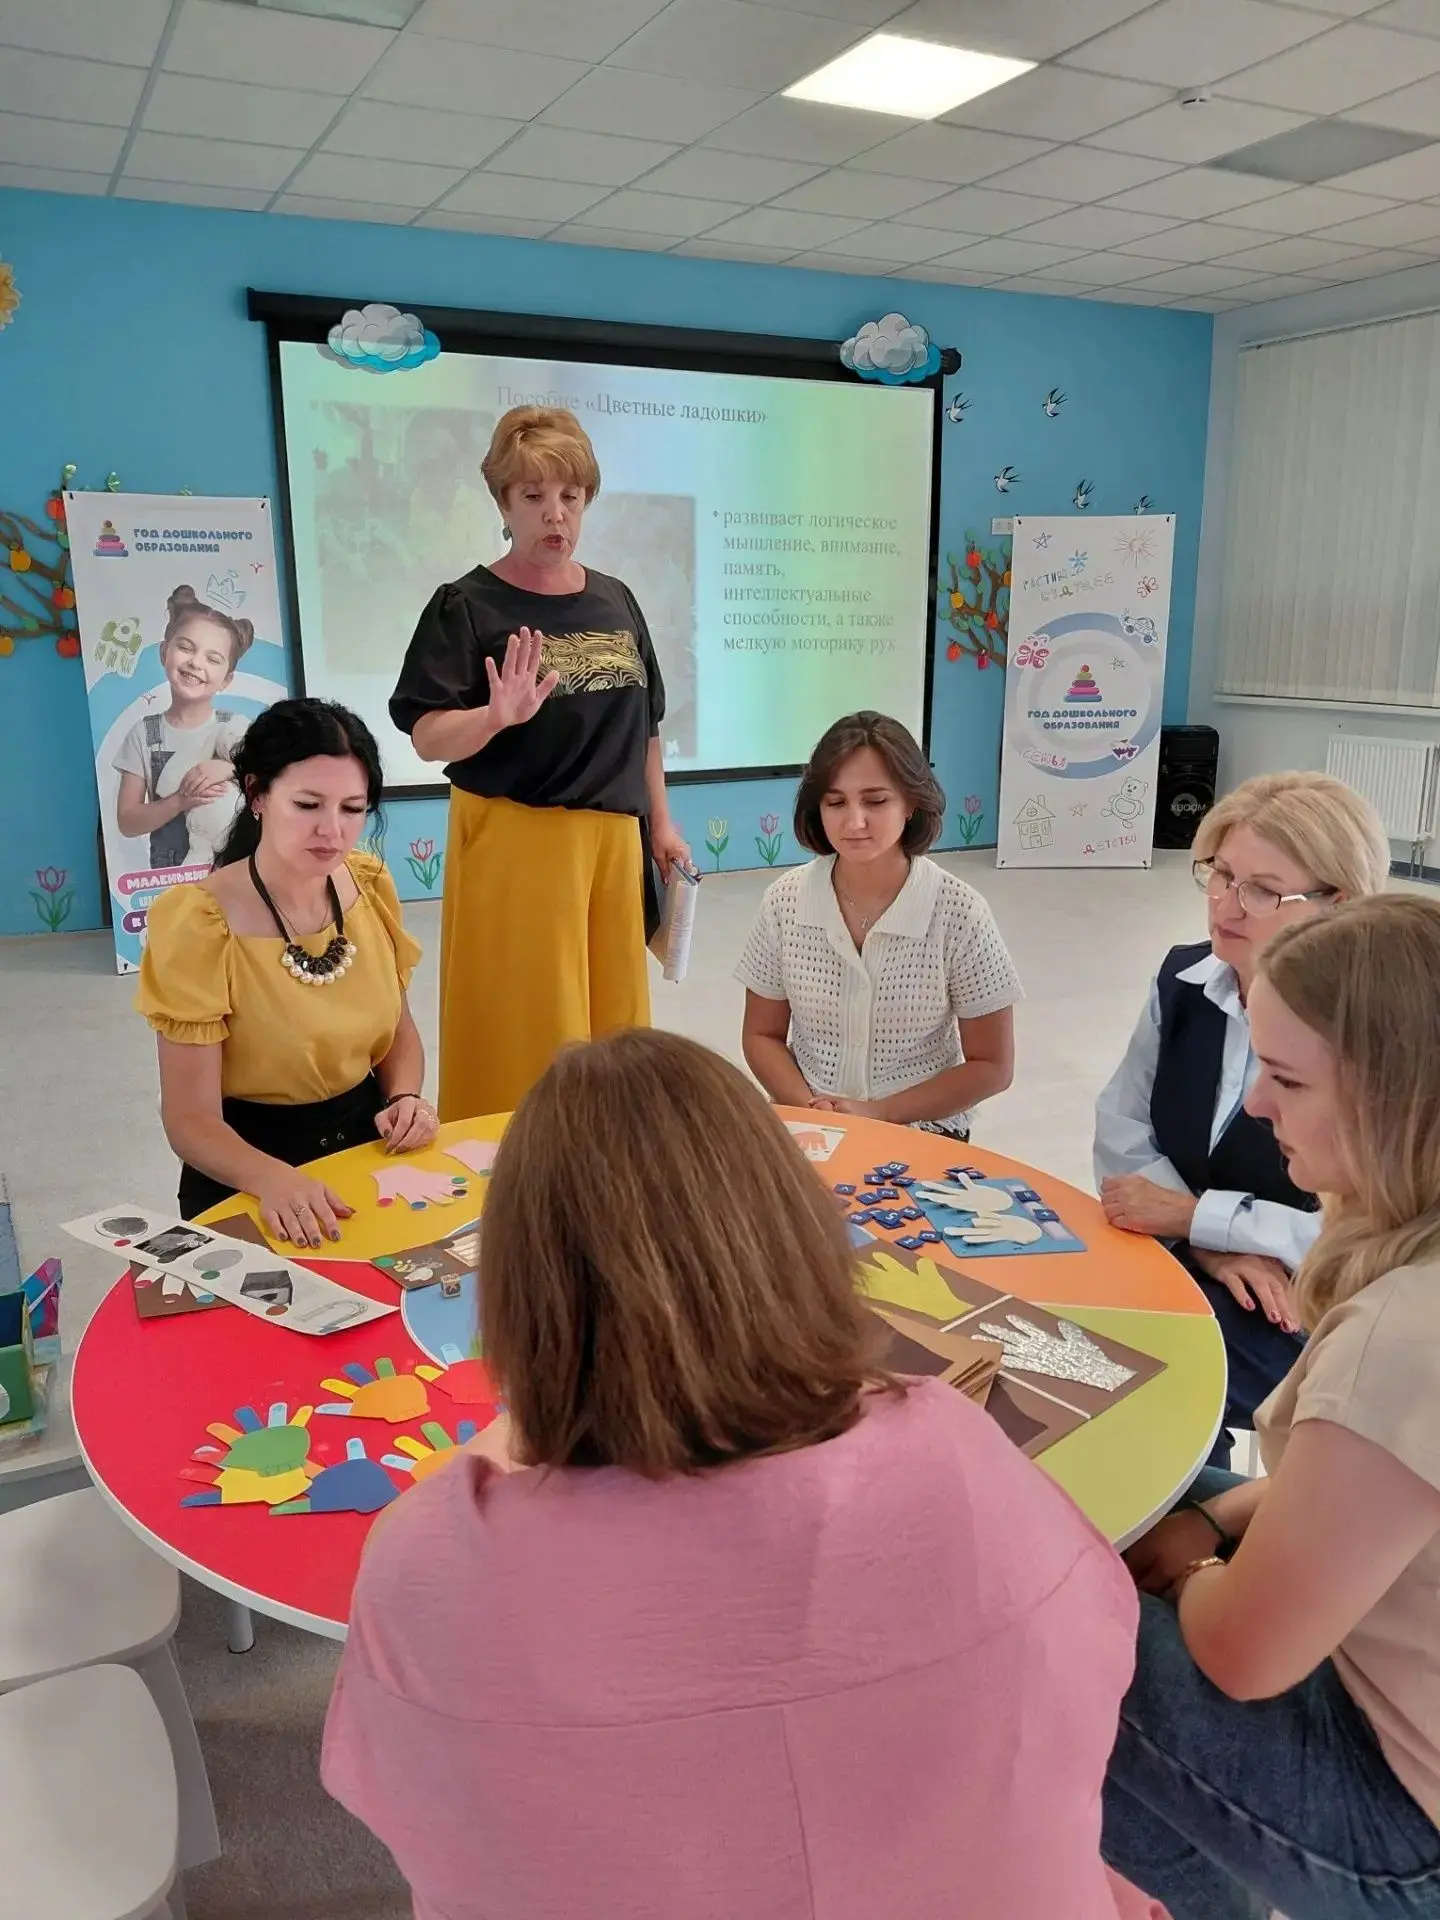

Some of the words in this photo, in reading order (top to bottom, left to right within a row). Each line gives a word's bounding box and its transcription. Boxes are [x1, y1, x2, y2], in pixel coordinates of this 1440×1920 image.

[497, 385, 580, 410] Пособие
[585, 393, 675, 419] «Цветные
[680, 402, 767, 424] ладошки»
[723, 510, 804, 529] развивает
[808, 512, 897, 530] логическое
[133, 528, 160, 539] ГОД
[162, 529, 253, 540] ДОШКОЛЬНОГО
[135, 542, 220, 553] ОБРАЗОВАНИЯ
[723, 535, 816, 553] мышление,
[821, 538, 901, 556] внимание,
[723, 560, 786, 578] память,
[723, 586, 872, 606] интеллектуальные
[723, 608, 831, 628] способности,
[836, 617, 844, 626] а
[848, 616, 894, 627] также
[723, 636, 786, 655] мелкую
[791, 638, 866, 654] моторику
[1052, 709, 1137, 718] ДОШКОЛЬНОГО
[1043, 721, 1120, 730] ОБРАЗОВАНИЯ
